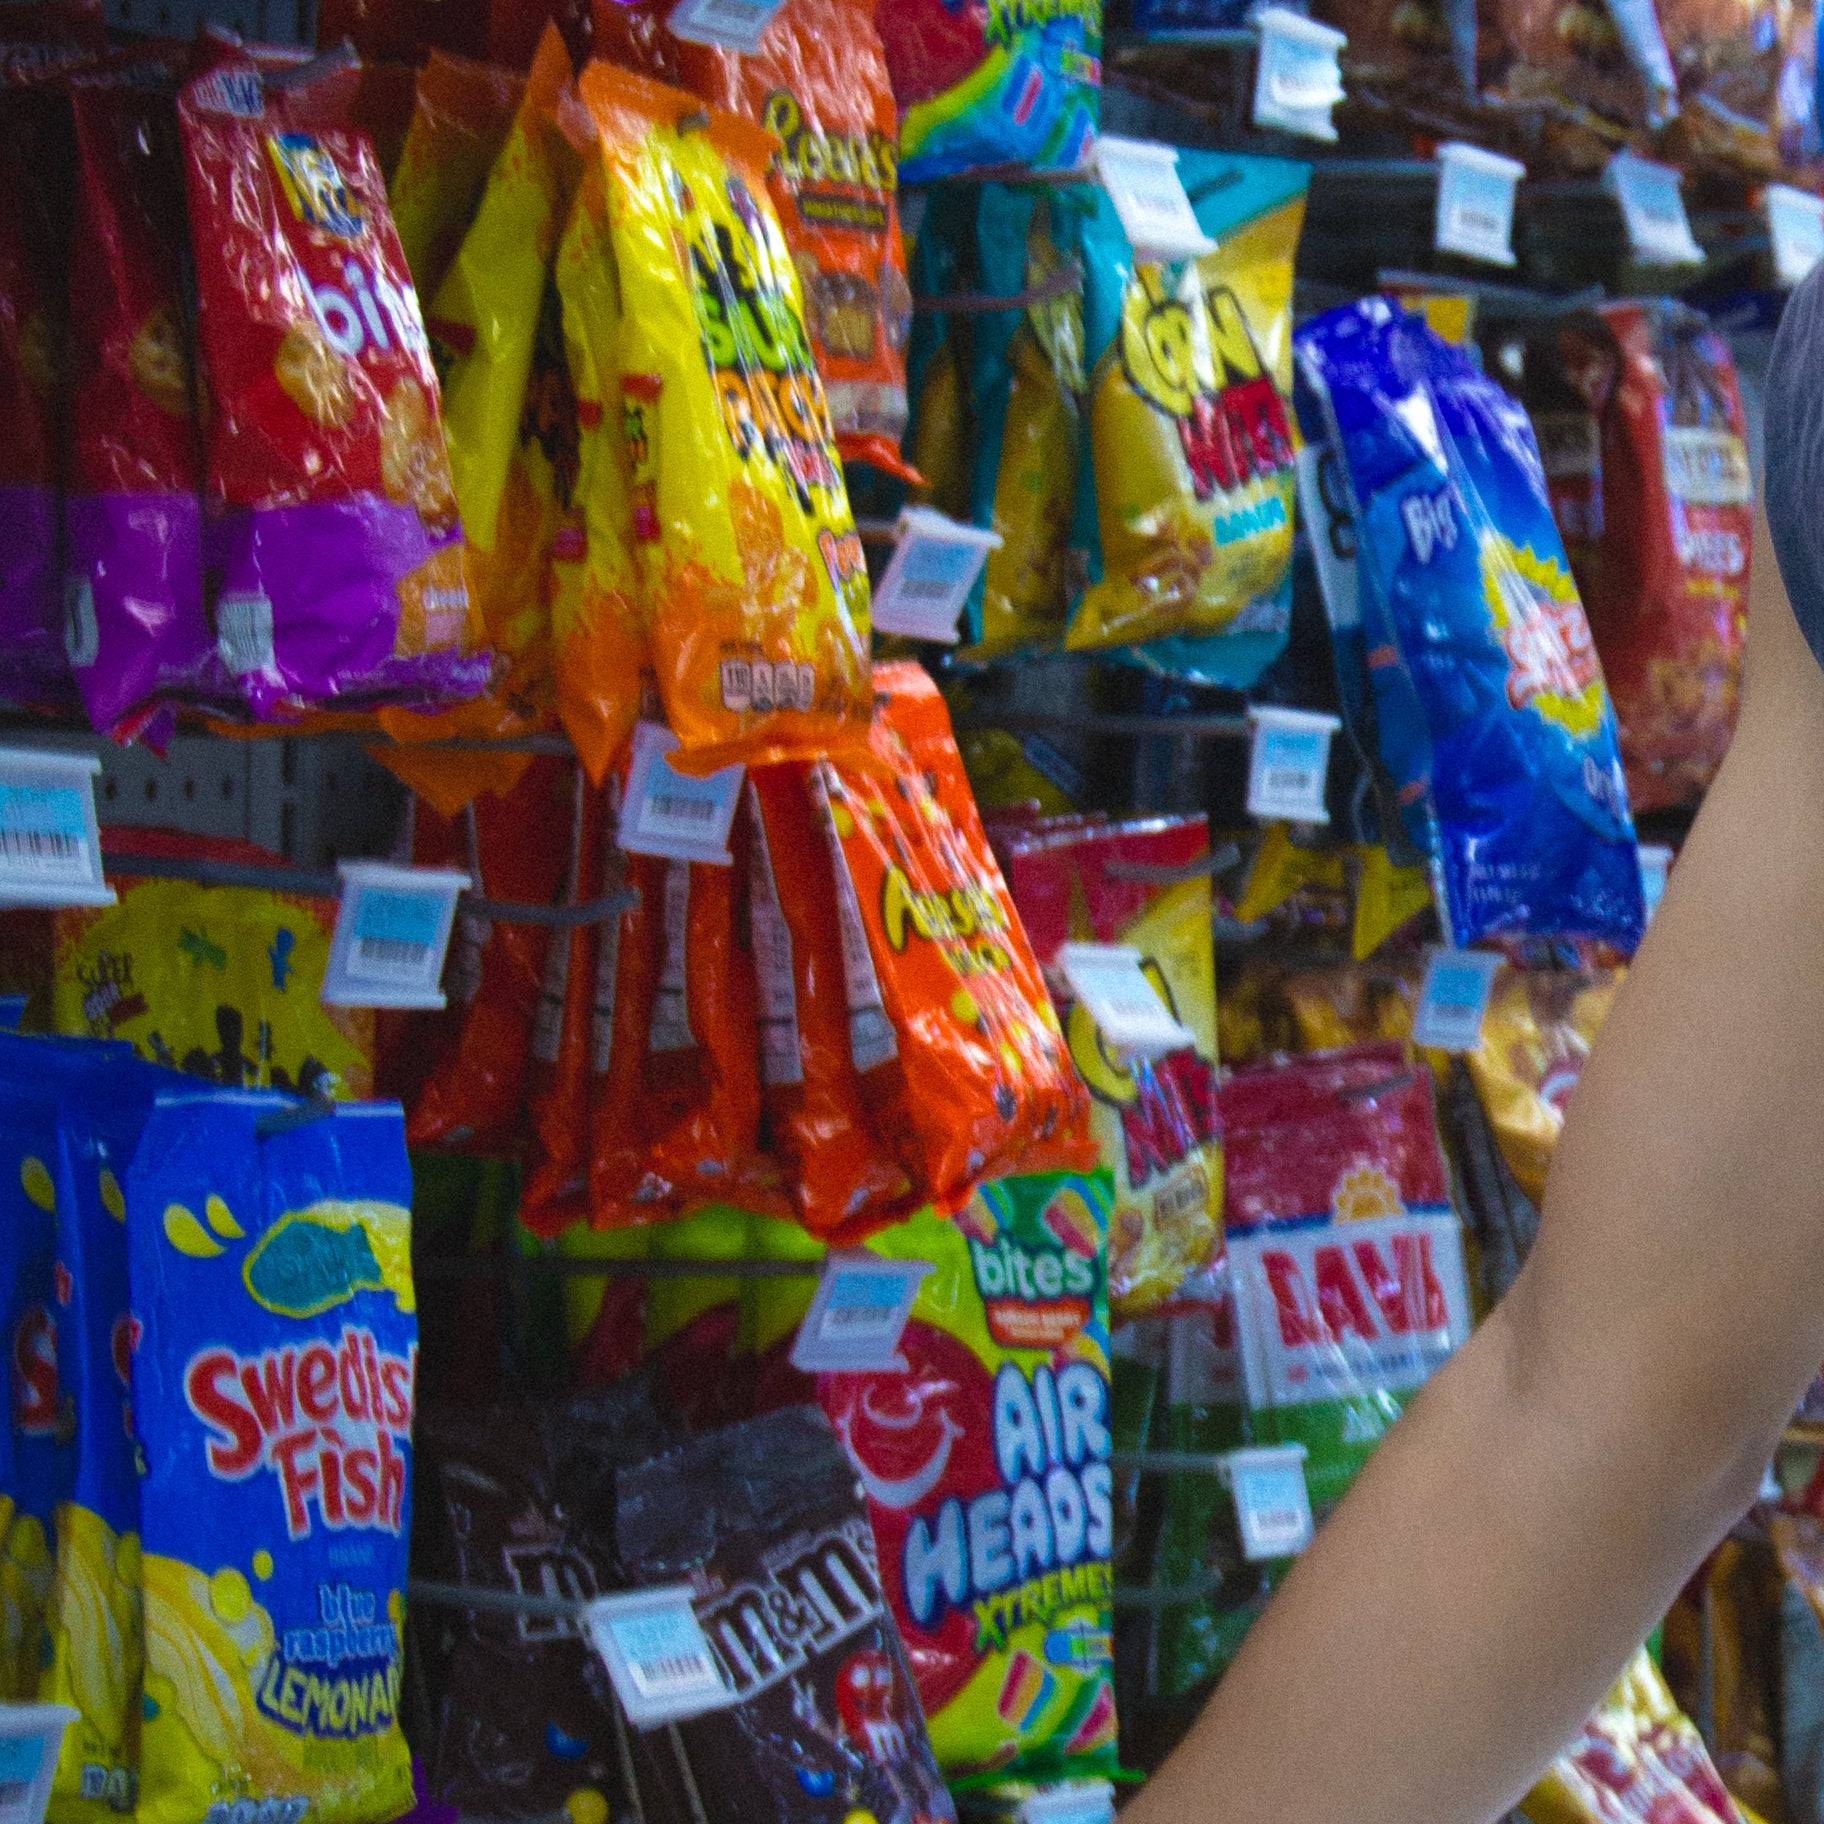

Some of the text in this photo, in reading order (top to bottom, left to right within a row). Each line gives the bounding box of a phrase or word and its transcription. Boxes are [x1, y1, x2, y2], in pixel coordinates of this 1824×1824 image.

[976, 1240, 1095, 1300] bites
[188, 1323, 418, 1476] Swedis
[993, 1360, 1111, 1485] AIR
[272, 1425, 407, 1536] Fish
[904, 1460, 1111, 1627] HEADS
